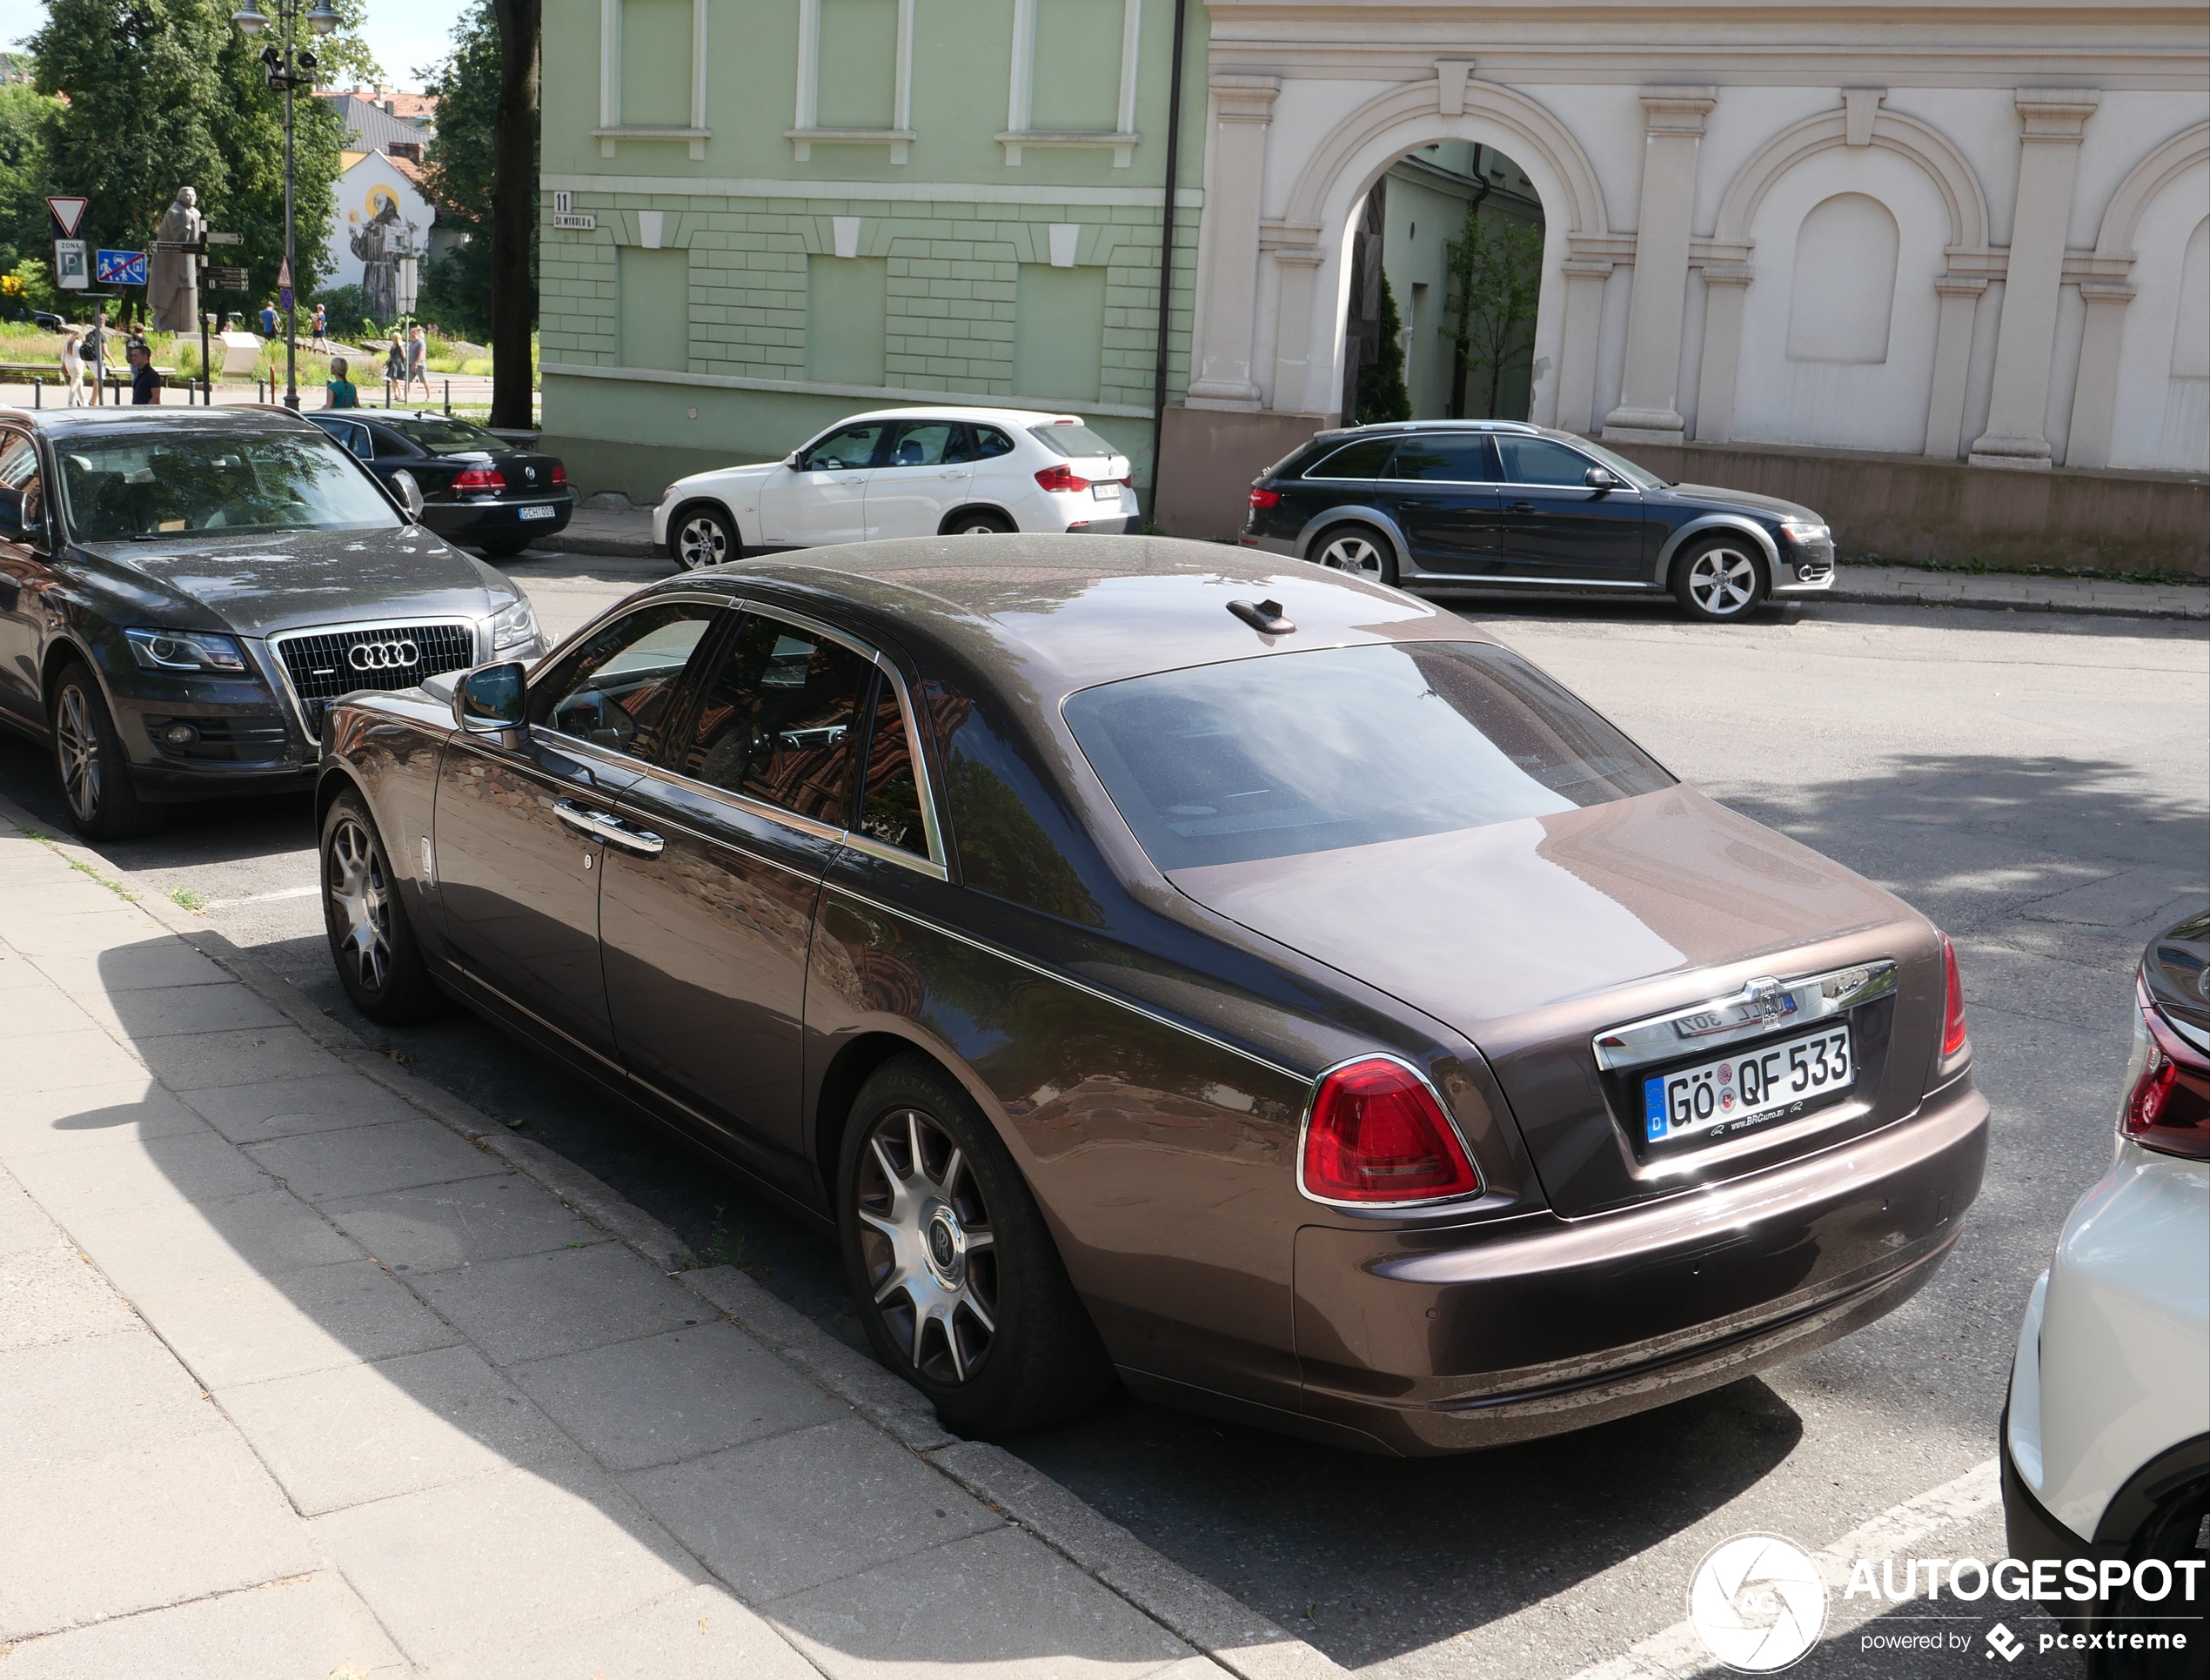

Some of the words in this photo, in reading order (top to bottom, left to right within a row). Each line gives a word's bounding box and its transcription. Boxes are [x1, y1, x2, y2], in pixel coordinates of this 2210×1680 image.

[556, 193, 567, 211] 11
[564, 217, 586, 226] MYKOLO
[1668, 1070, 1714, 1128] GÖ
[1738, 1052, 1780, 1107] QF
[1789, 1033, 1847, 1093] 533
[1652, 1117, 1661, 1131] D
